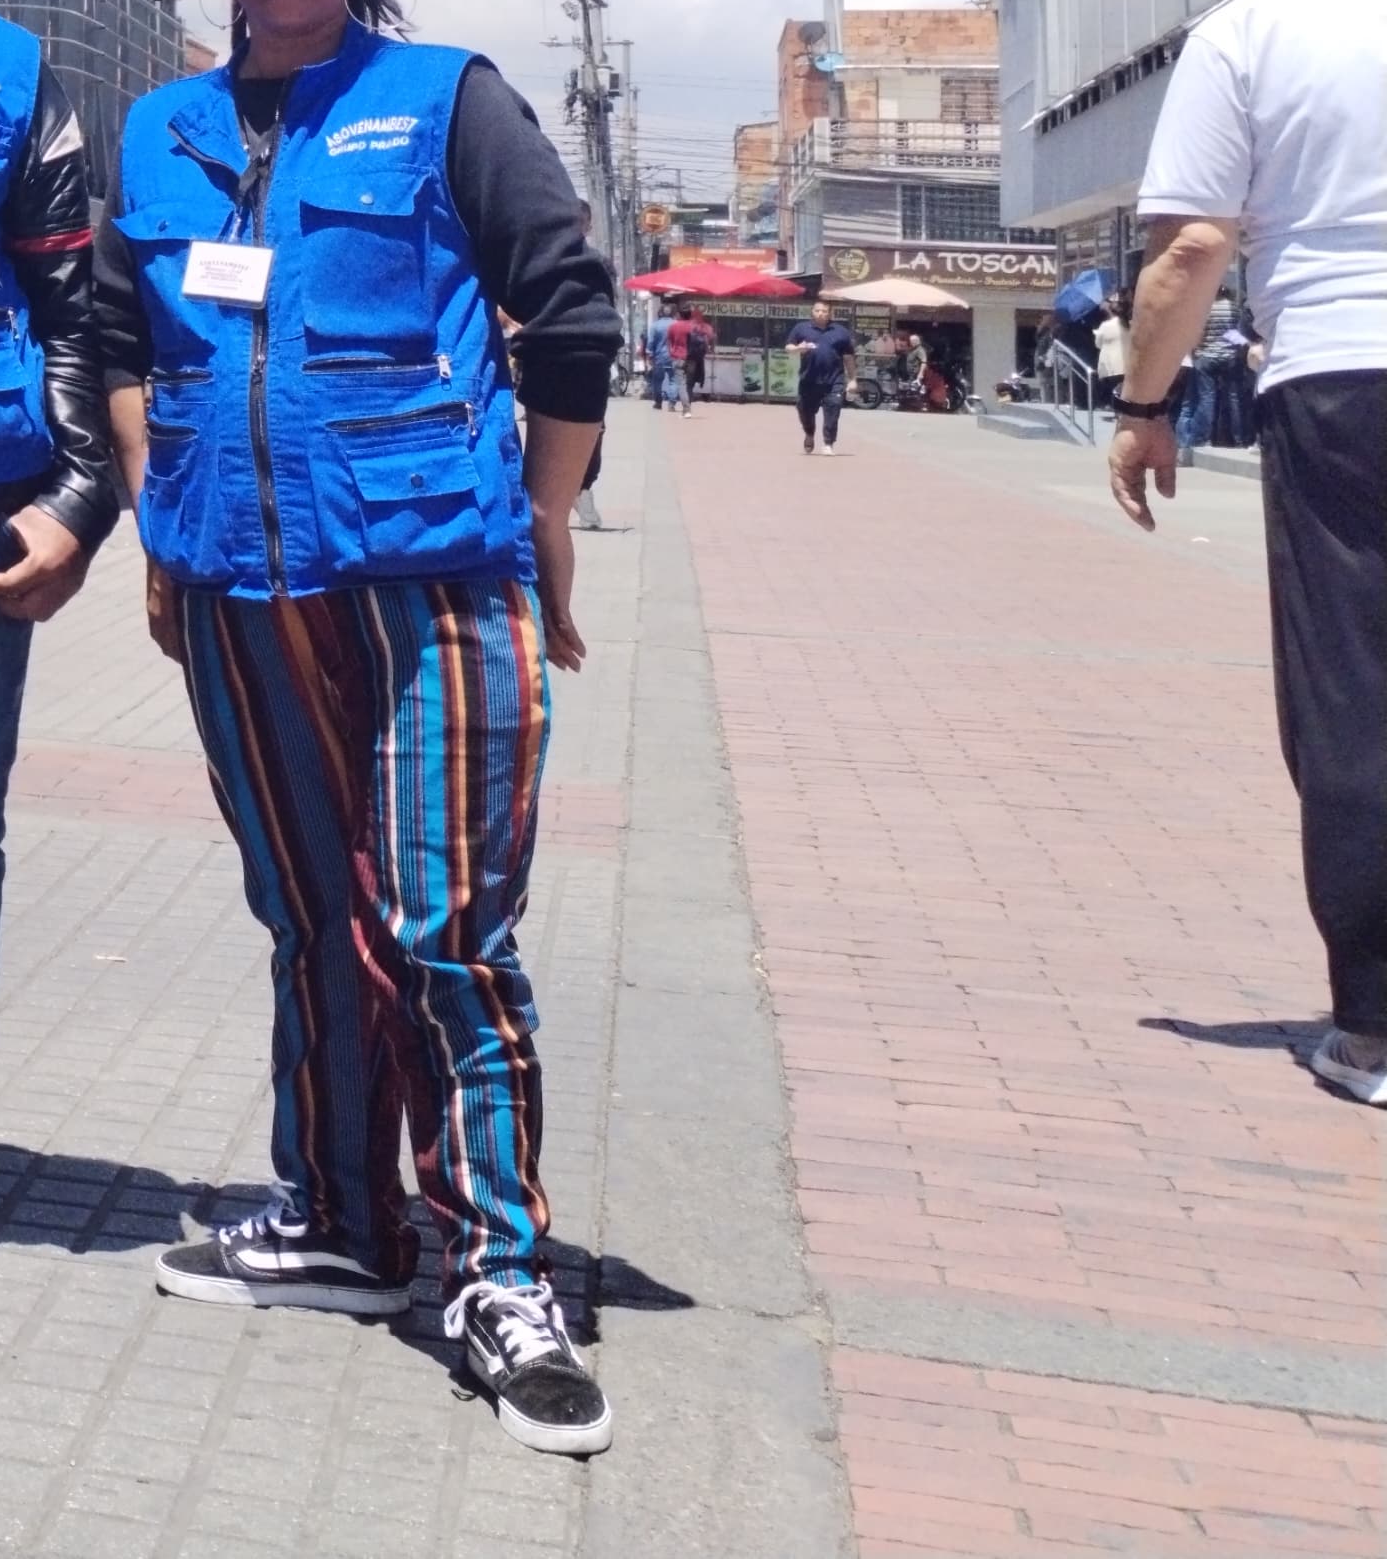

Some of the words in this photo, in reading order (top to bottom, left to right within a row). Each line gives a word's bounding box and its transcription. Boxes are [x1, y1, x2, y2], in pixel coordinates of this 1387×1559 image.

[325, 116, 419, 149] ASOVENAMBEST
[329, 141, 366, 157] GRUPO
[369, 135, 410, 151] PRADO
[893, 250, 930, 271] LA
